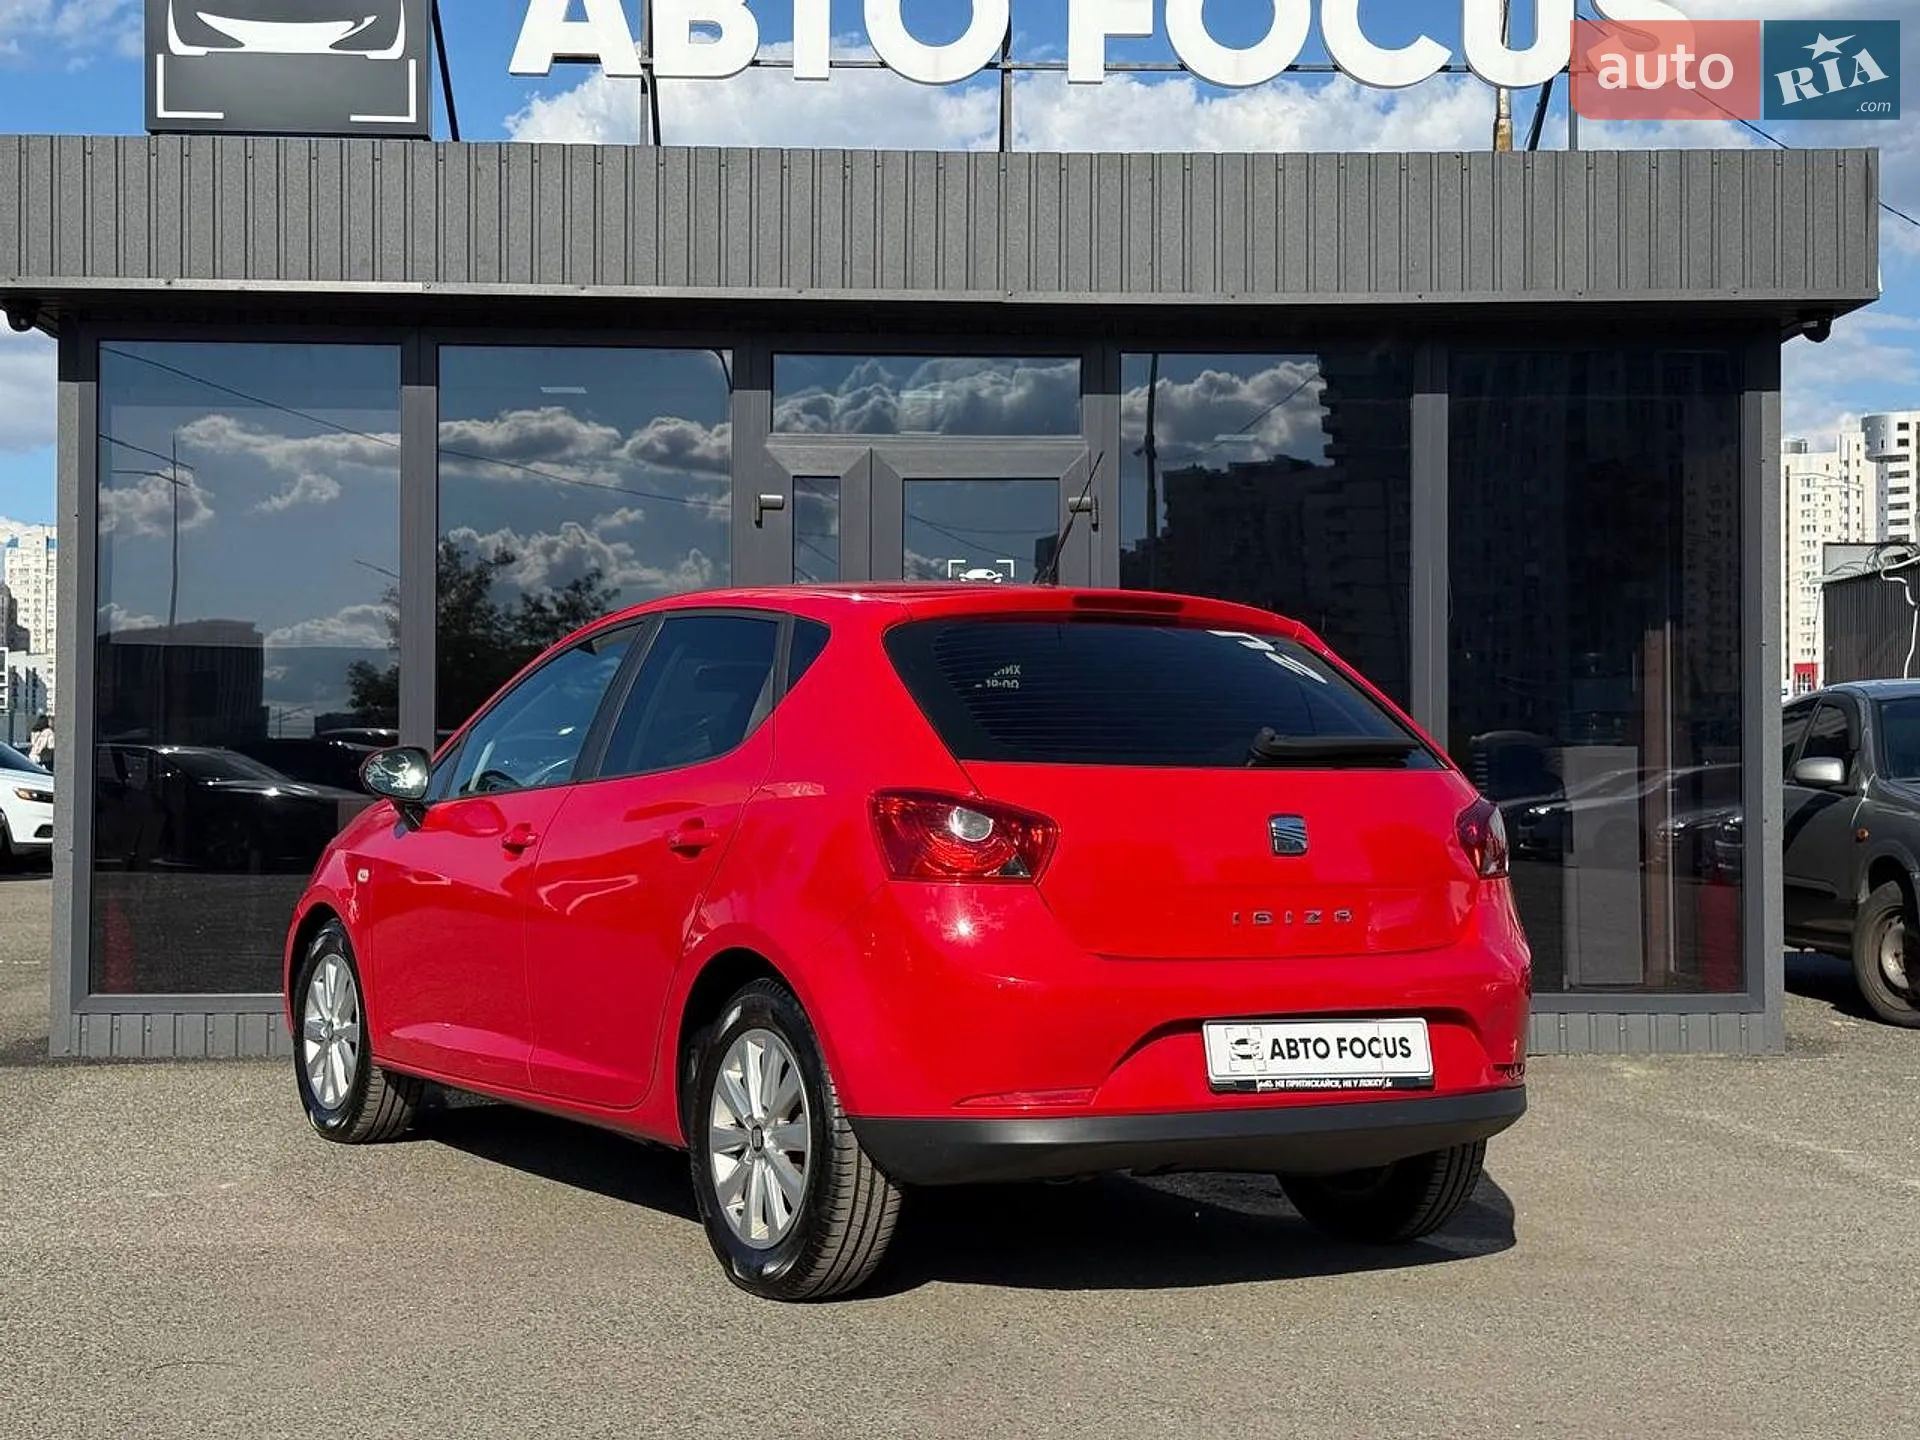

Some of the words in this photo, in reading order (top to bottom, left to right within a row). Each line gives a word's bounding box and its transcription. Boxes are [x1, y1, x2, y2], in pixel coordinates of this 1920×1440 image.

[1232, 908, 1353, 925] IBIZA
[1270, 1037, 1330, 1060] АВТО
[1338, 1036, 1412, 1060] FOCUS
